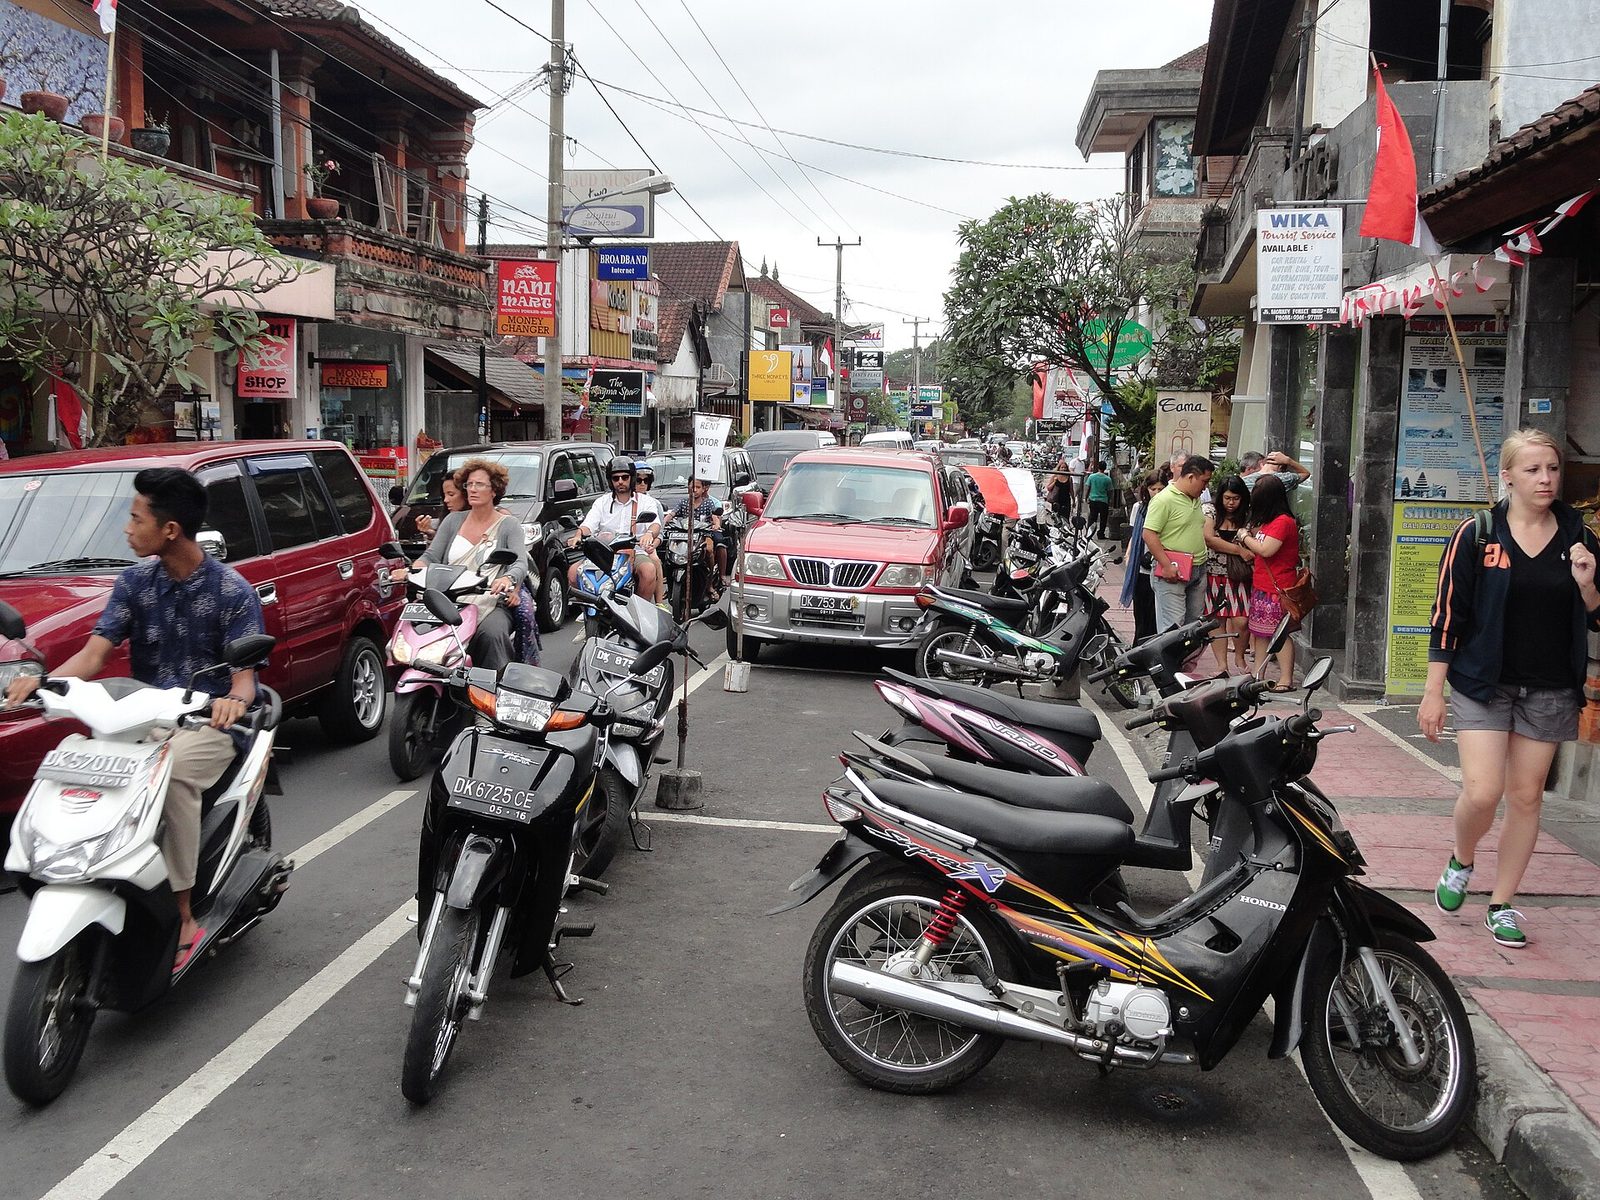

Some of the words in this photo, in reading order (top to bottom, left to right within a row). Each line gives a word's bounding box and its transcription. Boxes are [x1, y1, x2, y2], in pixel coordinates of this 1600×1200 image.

[1270, 213, 1329, 228] WIKA
[1261, 230, 1298, 241] Tourist
[1300, 230, 1337, 240] Service
[600, 254, 648, 265] BROADBAND
[611, 266, 635, 275] Internet
[502, 279, 552, 295] NANI
[501, 296, 552, 309] MART
[507, 315, 544, 325] MONEY
[501, 324, 550, 334] CHANGER
[1420, 337, 1449, 345] DAILY
[335, 369, 376, 378] MONEY
[244, 376, 287, 389] SHOP
[327, 377, 383, 386] CHANGER
[609, 376, 623, 388] The
[618, 385, 640, 401] Spa
[699, 421, 720, 431] RENT
[697, 453, 712, 464] BIKE
[801, 595, 813, 607] DK
[817, 596, 835, 609] 753
[839, 598, 852, 610] KJ
[405, 605, 418, 614] DK
[988, 718, 1059, 760] VARIO
[453, 777, 477, 796] DK
[475, 782, 513, 804] 6725
[514, 791, 535, 809] CE
[863, 824, 968, 874] Supra
[1239, 894, 1288, 912] HONDA
[1018, 928, 1064, 943] ASTREA
